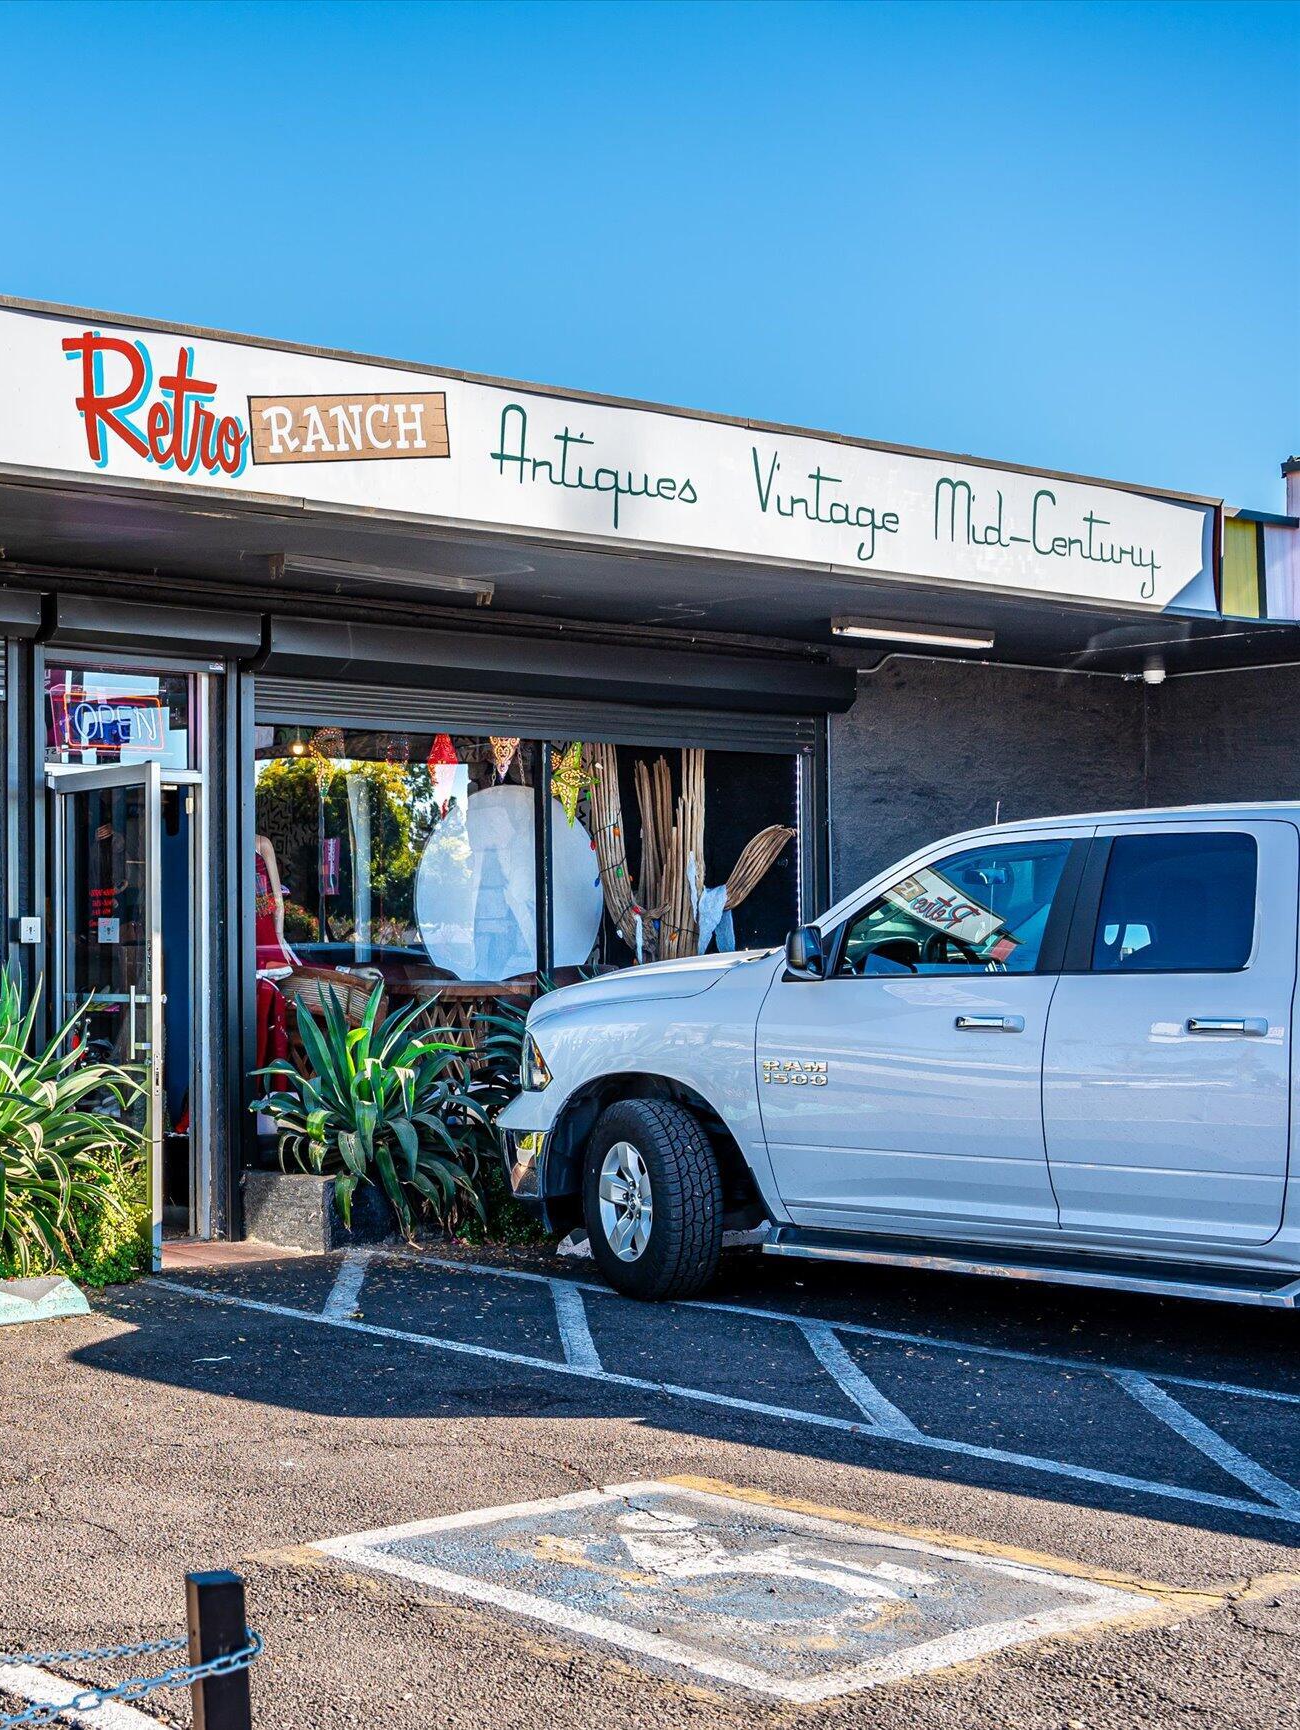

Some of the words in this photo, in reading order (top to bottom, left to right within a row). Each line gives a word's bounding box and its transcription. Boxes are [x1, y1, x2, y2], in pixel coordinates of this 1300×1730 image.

[62, 331, 249, 478] Retro
[261, 402, 427, 454] RANCH
[490, 404, 699, 529] Antiques
[752, 446, 900, 561] Vintage
[934, 477, 1161, 599] Mid-Century
[74, 703, 157, 741] OPEN
[762, 1060, 828, 1073] RAM
[763, 1073, 828, 1086] 1500
